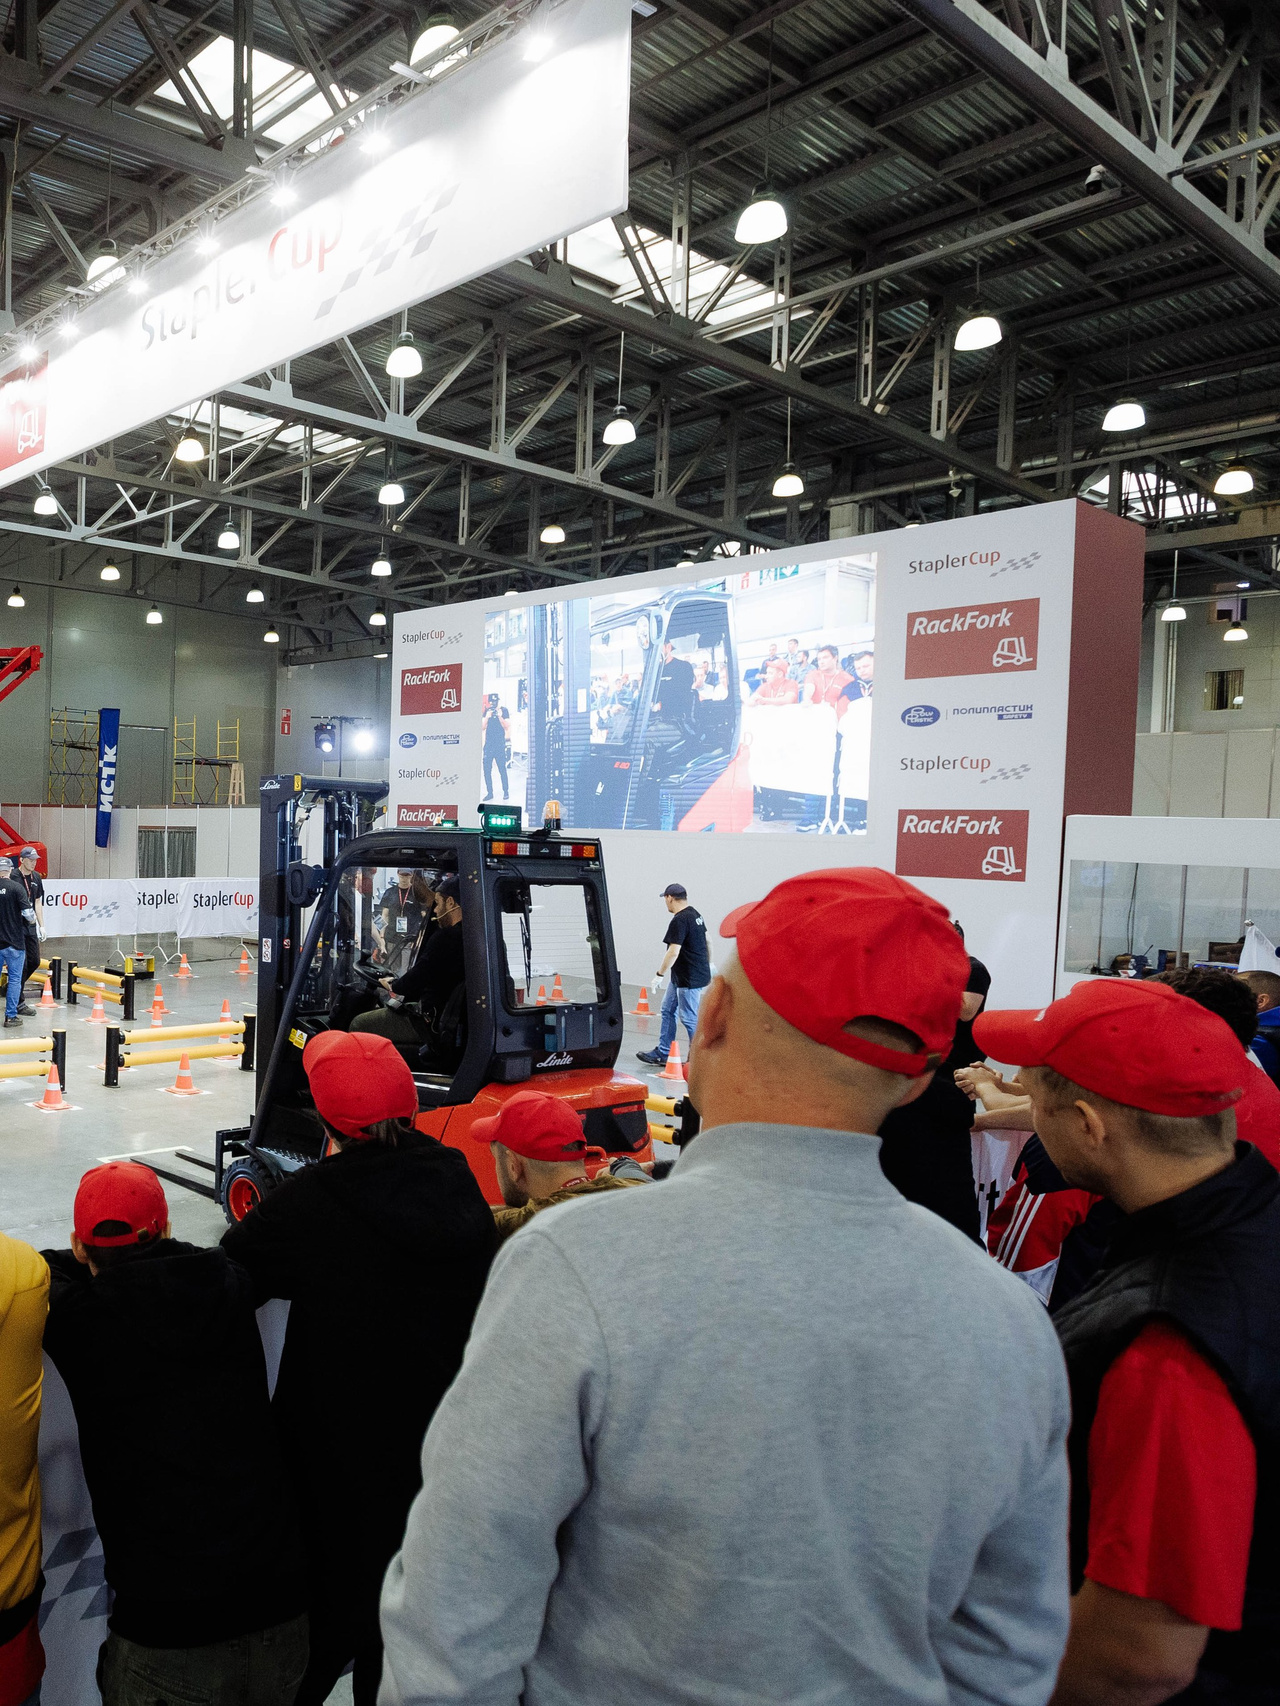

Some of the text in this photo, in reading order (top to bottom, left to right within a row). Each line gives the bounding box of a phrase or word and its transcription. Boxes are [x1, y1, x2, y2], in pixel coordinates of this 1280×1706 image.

[141, 208, 345, 351] StapleCup
[908, 551, 1001, 574] StaplerCup
[912, 608, 1014, 636] RackFork
[402, 630, 445, 644] StaplerCup
[403, 669, 451, 686] RackFork
[900, 756, 991, 773] StaplerCup
[398, 768, 441, 780] StaplerCup
[902, 815, 1003, 834] RackFork
[193, 890, 254, 911] StaplerCup
[536, 1051, 574, 1068] Linde
